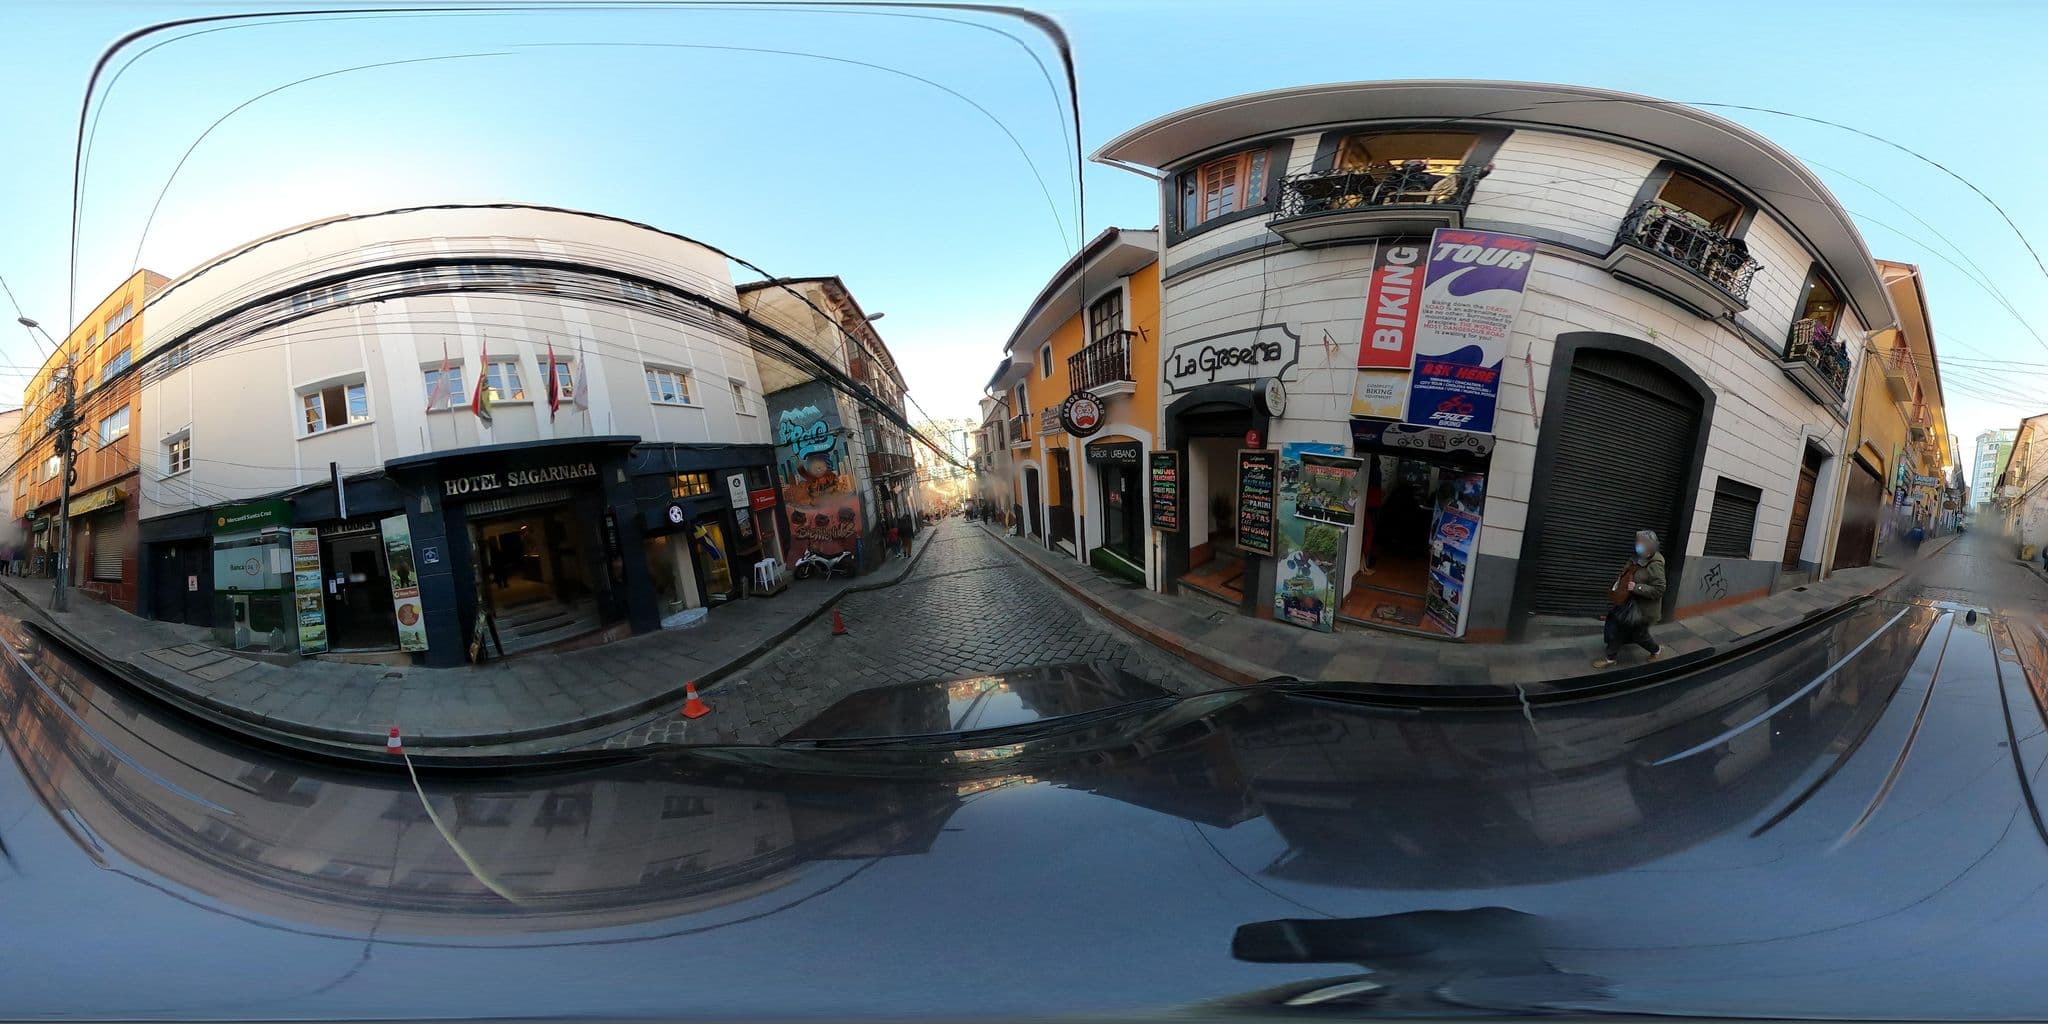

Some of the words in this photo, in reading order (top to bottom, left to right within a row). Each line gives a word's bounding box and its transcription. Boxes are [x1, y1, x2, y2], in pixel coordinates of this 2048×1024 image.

[1433, 243, 1531, 269] TOUR
[1371, 246, 1419, 352] BIKING
[1423, 322, 1441, 330] MOST
[1443, 325, 1485, 335] DANGEROUS
[1486, 330, 1505, 338] ROAD
[1174, 354, 1197, 378] La
[1455, 367, 1496, 383] HERE
[1064, 394, 1080, 418] SABOR
[1082, 393, 1105, 414] URBANO
[1428, 411, 1475, 423] SPACE
[1438, 420, 1462, 428] BIKING
[1090, 450, 1108, 458] SABOR
[1110, 449, 1137, 459] URBANO
[444, 474, 501, 496] HOTEL
[507, 462, 597, 487] SAGARNAGA
[1241, 512, 1270, 523] PASTAS
